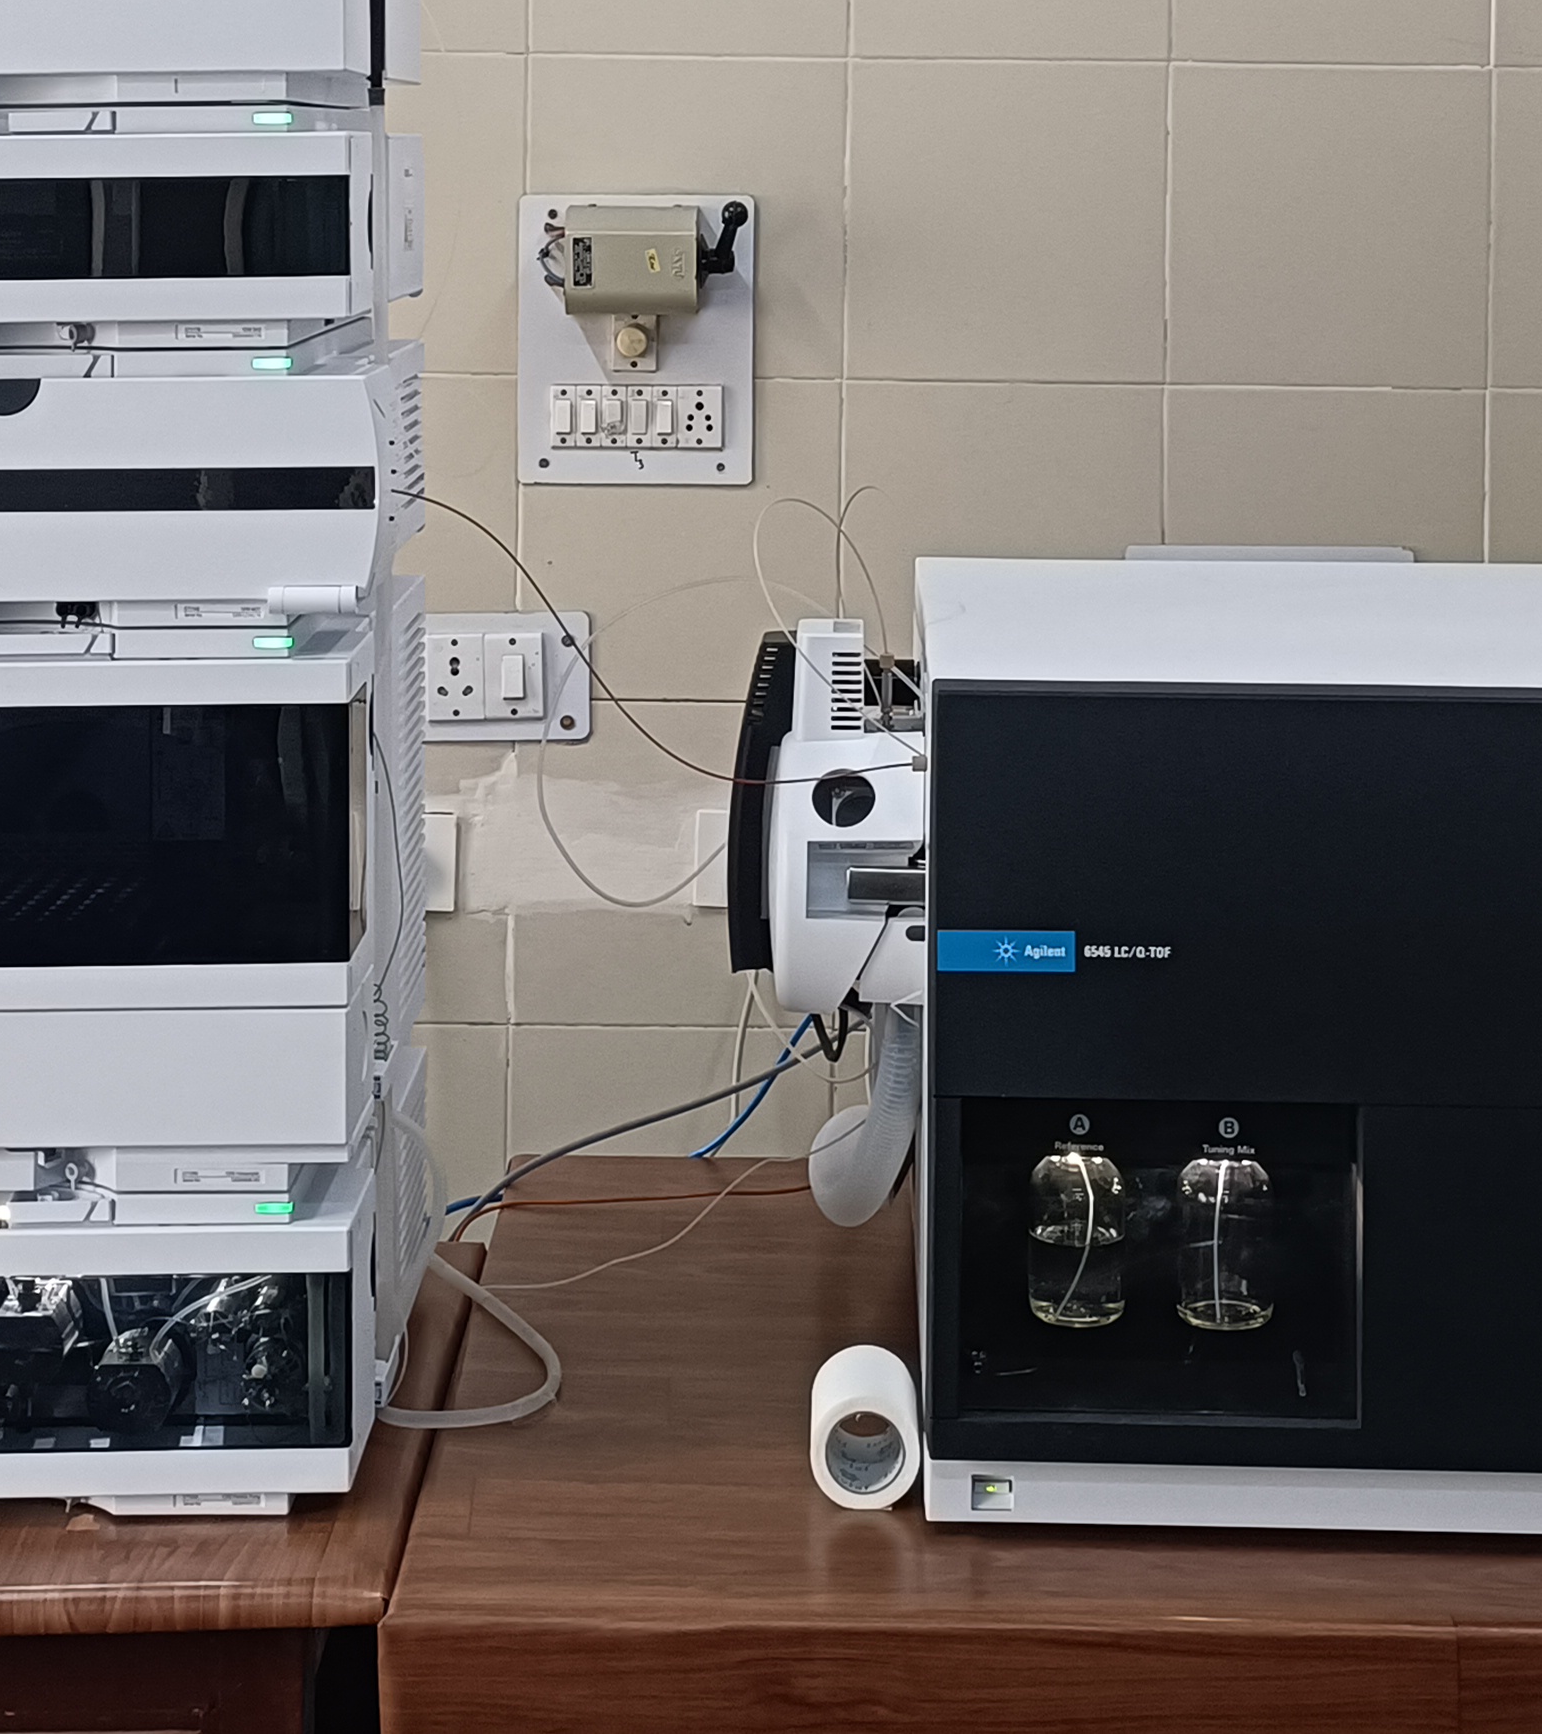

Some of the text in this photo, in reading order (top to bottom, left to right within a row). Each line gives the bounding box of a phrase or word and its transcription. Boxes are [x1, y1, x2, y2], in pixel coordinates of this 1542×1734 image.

[1024, 945, 1067, 960] Agilent
[1083, 945, 1172, 959] 6545 LC/Q-TOF
[1054, 1141, 1105, 1152] Reference
[1202, 1144, 1256, 1155] Tuning Mix
